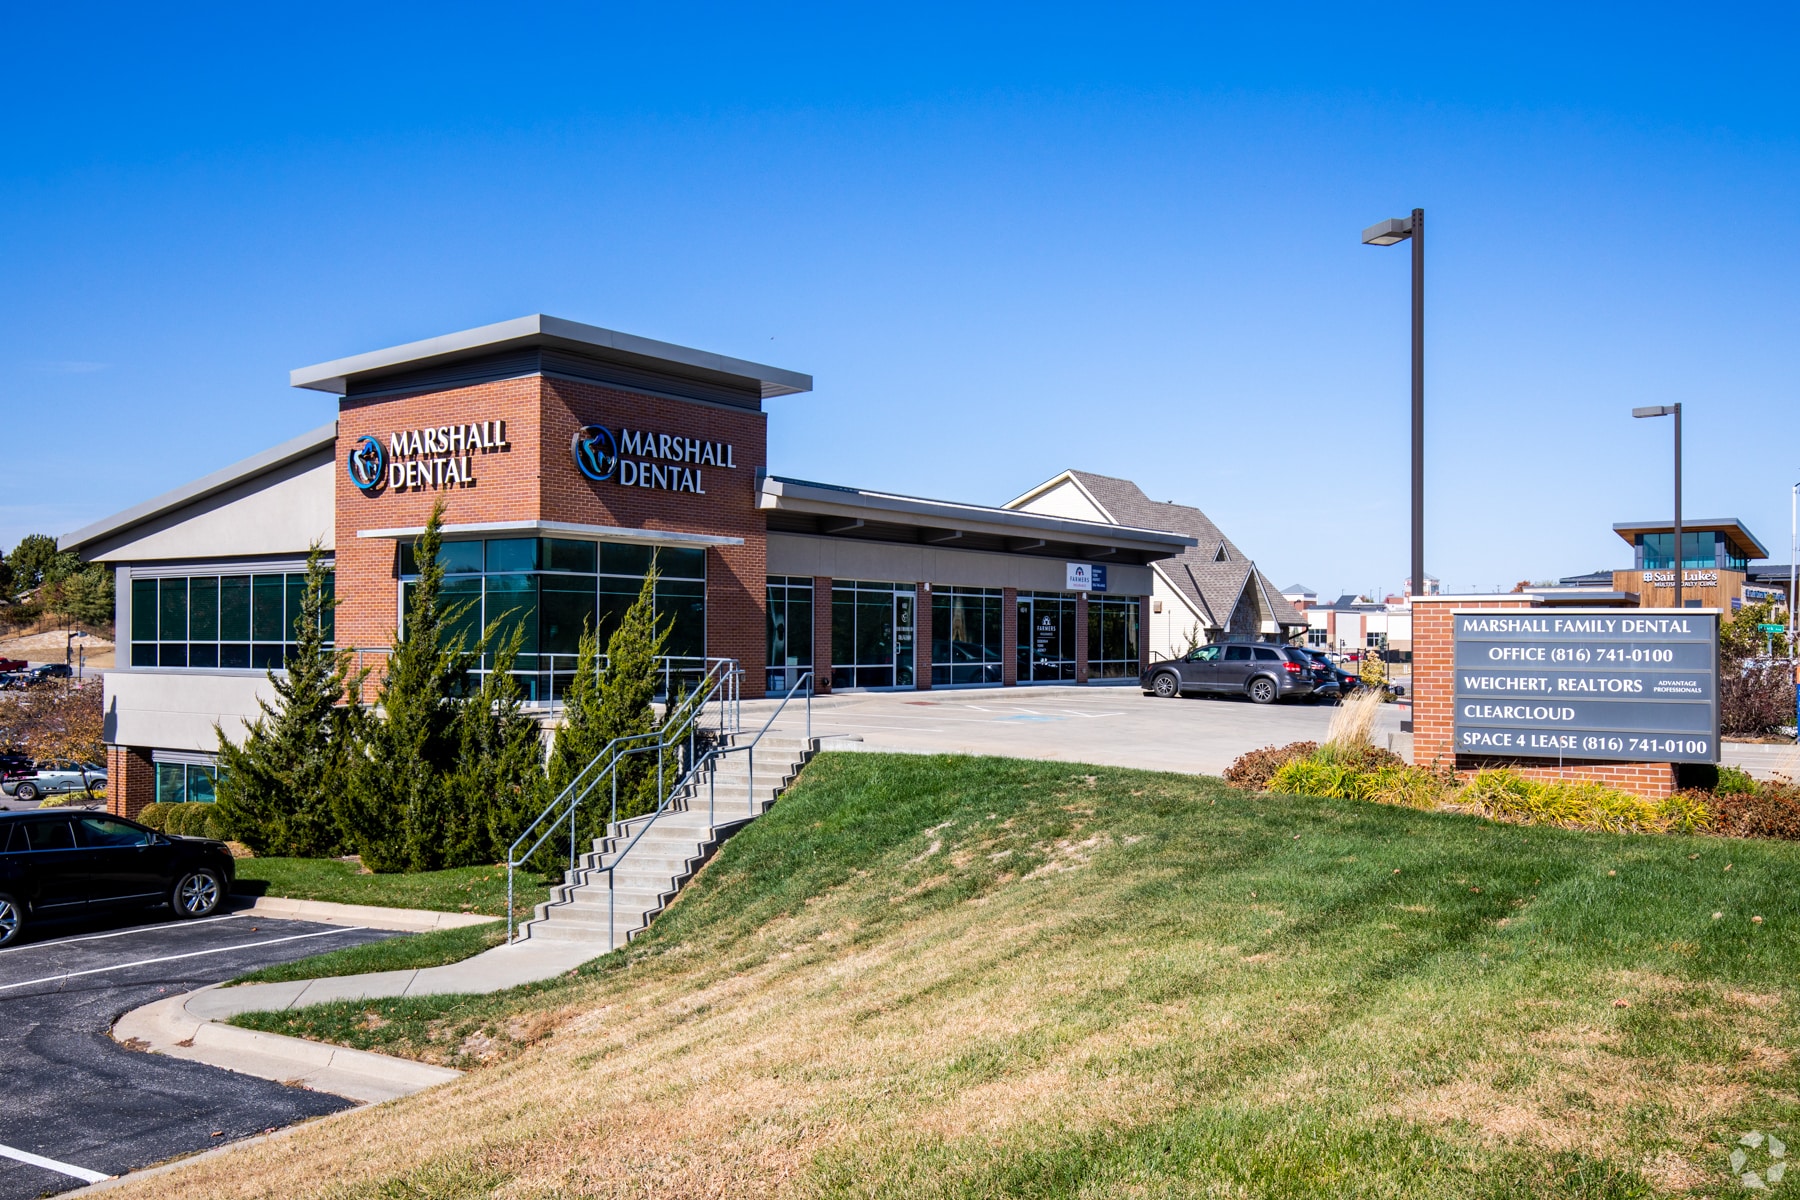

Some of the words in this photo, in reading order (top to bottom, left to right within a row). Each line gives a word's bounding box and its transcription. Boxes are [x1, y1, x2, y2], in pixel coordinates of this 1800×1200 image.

[389, 420, 506, 457] MARSHALL
[620, 428, 737, 468] MARSHALL
[389, 456, 473, 489] DENTAL
[620, 459, 706, 494] DENTAL
[1654, 571, 1675, 581] Sain
[1684, 571, 1717, 581] Luke's
[1463, 619, 1550, 632] MARSHALL
[1554, 619, 1617, 633] FAMILY
[1622, 620, 1691, 633] DENTAL
[1488, 647, 1546, 661] OFFICE
[1551, 648, 1591, 663] (816)
[1596, 648, 1673, 663] 741-0100
[1464, 676, 1553, 693] WEICHERT,
[1558, 678, 1643, 693] REALTORS
[1653, 686, 1702, 694] PROFESSIONALS
[1464, 704, 1575, 721] CLEARCLOUD
[1463, 732, 1512, 747] SPACE
[1516, 734, 1526, 747] 4
[1531, 735, 1577, 749] LEASE
[1582, 736, 1623, 752] (816)
[1629, 738, 1707, 754] 741-0100
